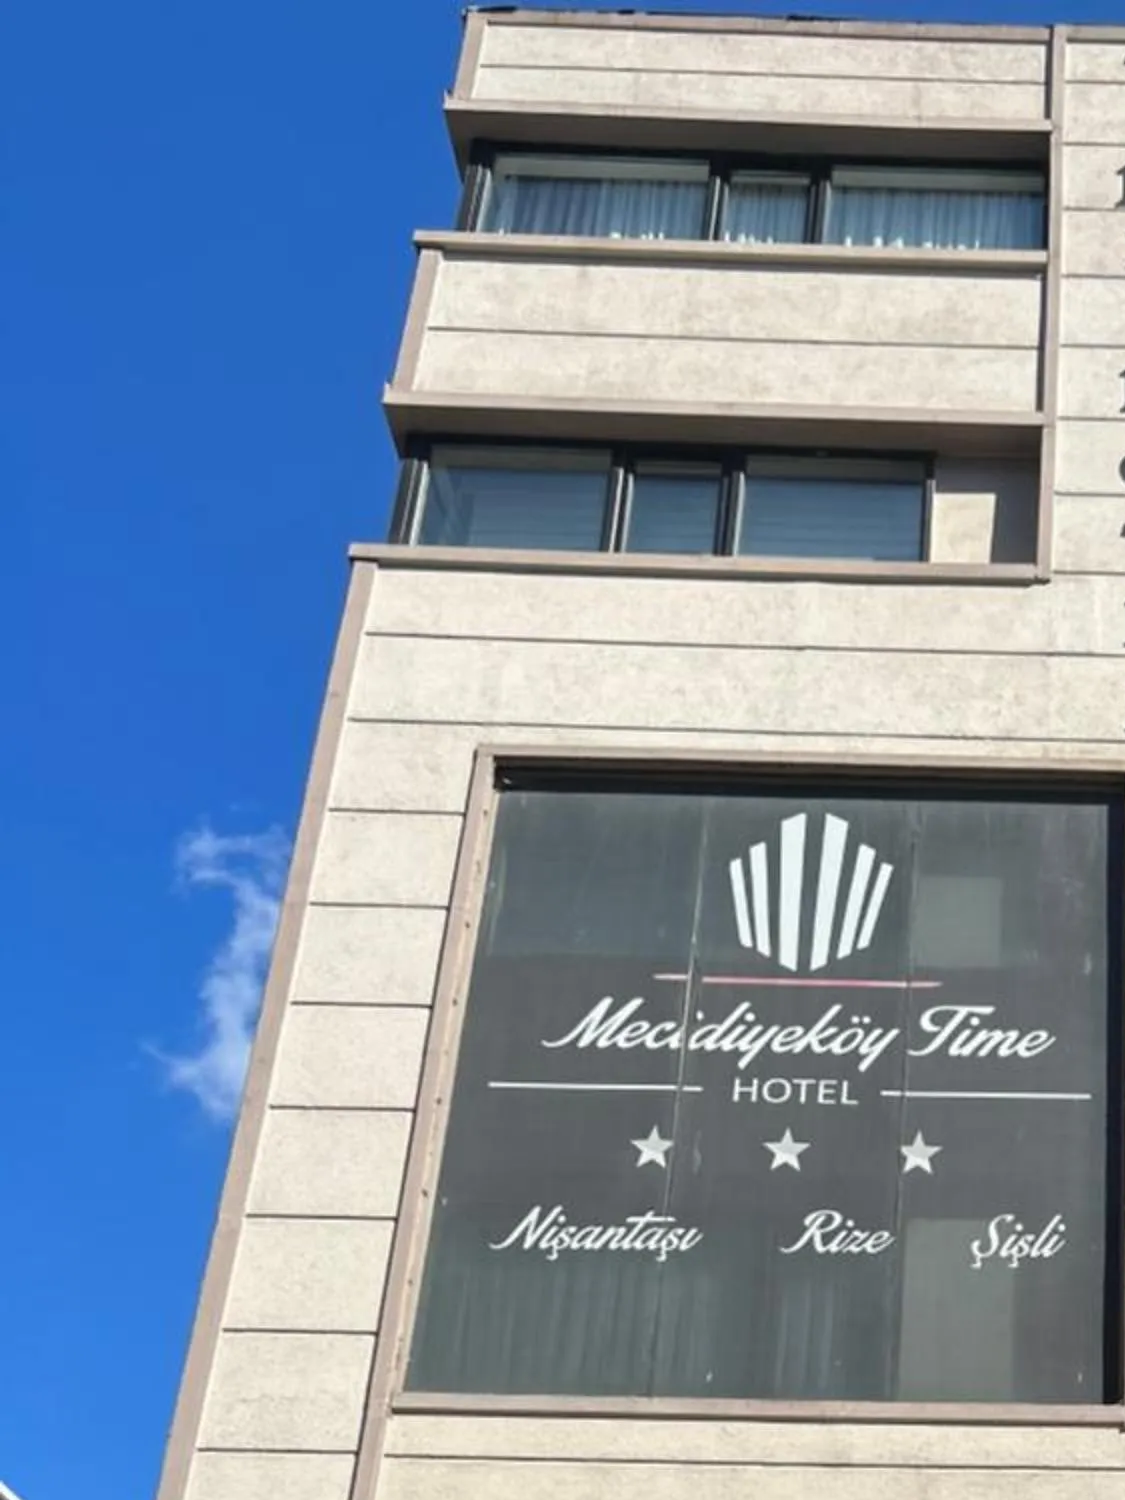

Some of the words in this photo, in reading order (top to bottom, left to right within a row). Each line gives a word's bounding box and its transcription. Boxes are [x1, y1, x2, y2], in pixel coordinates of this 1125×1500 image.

[540, 995, 901, 1073] Mecidiyeköy
[907, 1004, 1056, 1059] Time
[731, 1077, 859, 1106] HOTEL
[489, 1204, 704, 1262] Nişantaşı
[778, 1209, 896, 1255] Rize
[969, 1213, 1067, 1269] Şişli
